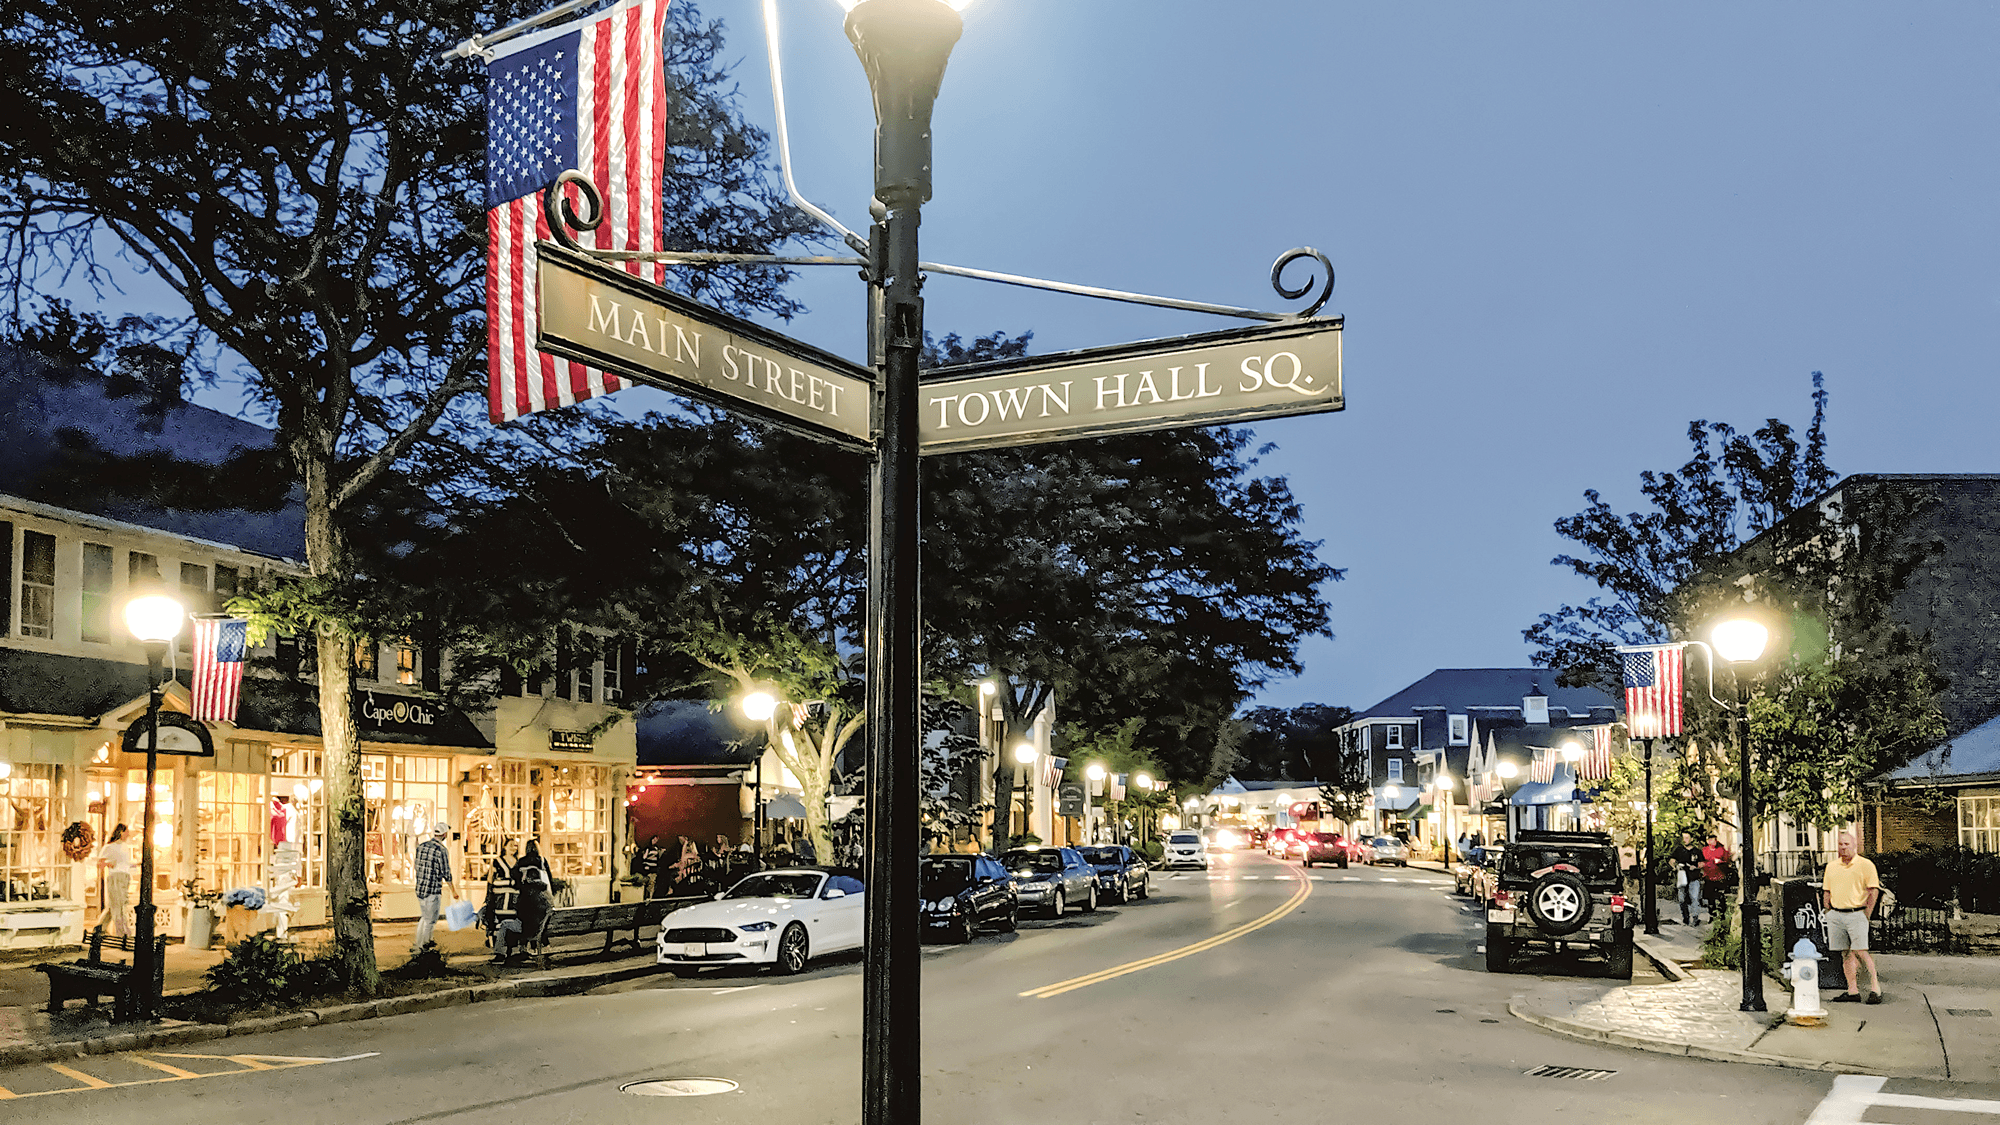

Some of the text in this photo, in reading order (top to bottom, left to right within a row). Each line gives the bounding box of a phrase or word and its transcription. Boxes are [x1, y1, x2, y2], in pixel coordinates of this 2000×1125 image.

[586, 293, 844, 417] MAIN STREET
[929, 352, 1328, 429] TOWN HALL SQ.
[363, 699, 434, 726] Cape Chic
